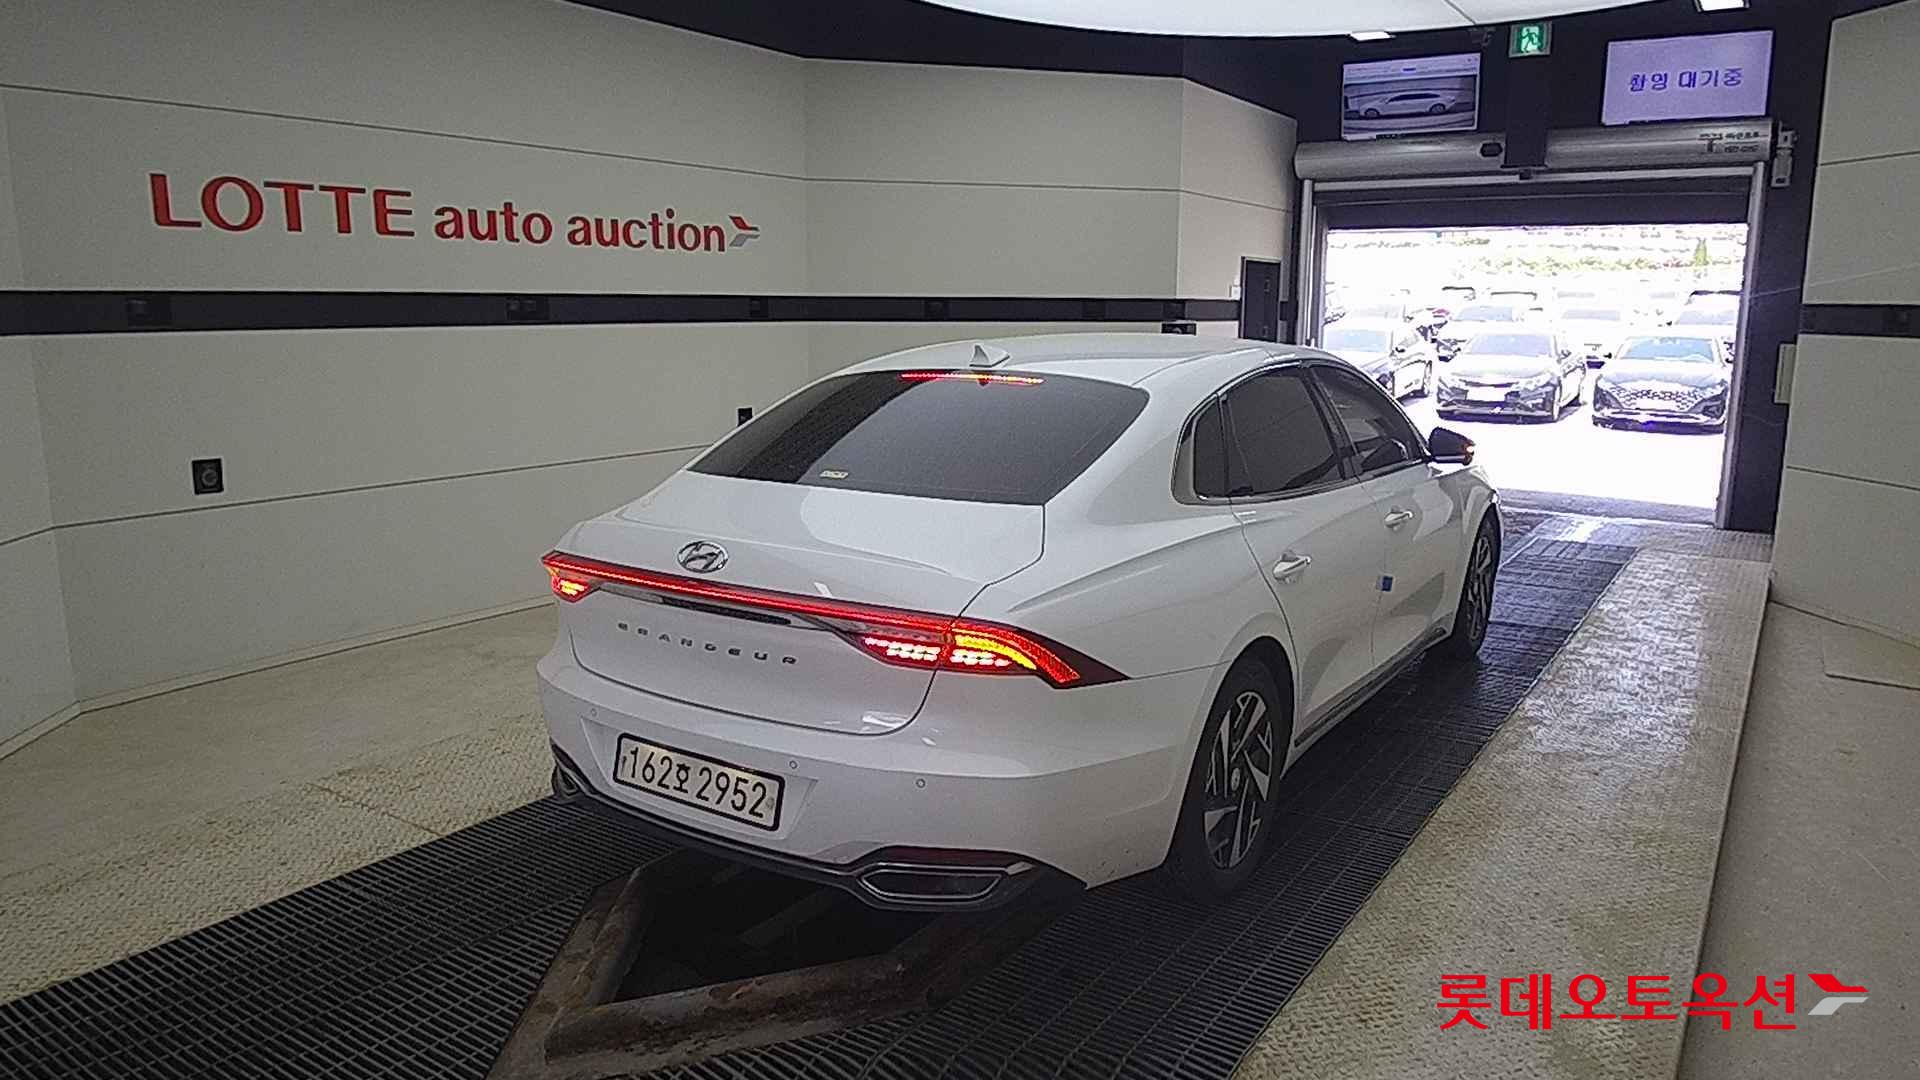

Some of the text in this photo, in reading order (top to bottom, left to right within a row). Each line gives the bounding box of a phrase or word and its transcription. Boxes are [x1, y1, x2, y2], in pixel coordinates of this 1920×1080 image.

[1678, 67, 1742, 89] 대기중
[148, 173, 726, 253] LOTTE auto auction
[617, 622, 797, 664] GRANDEUR
